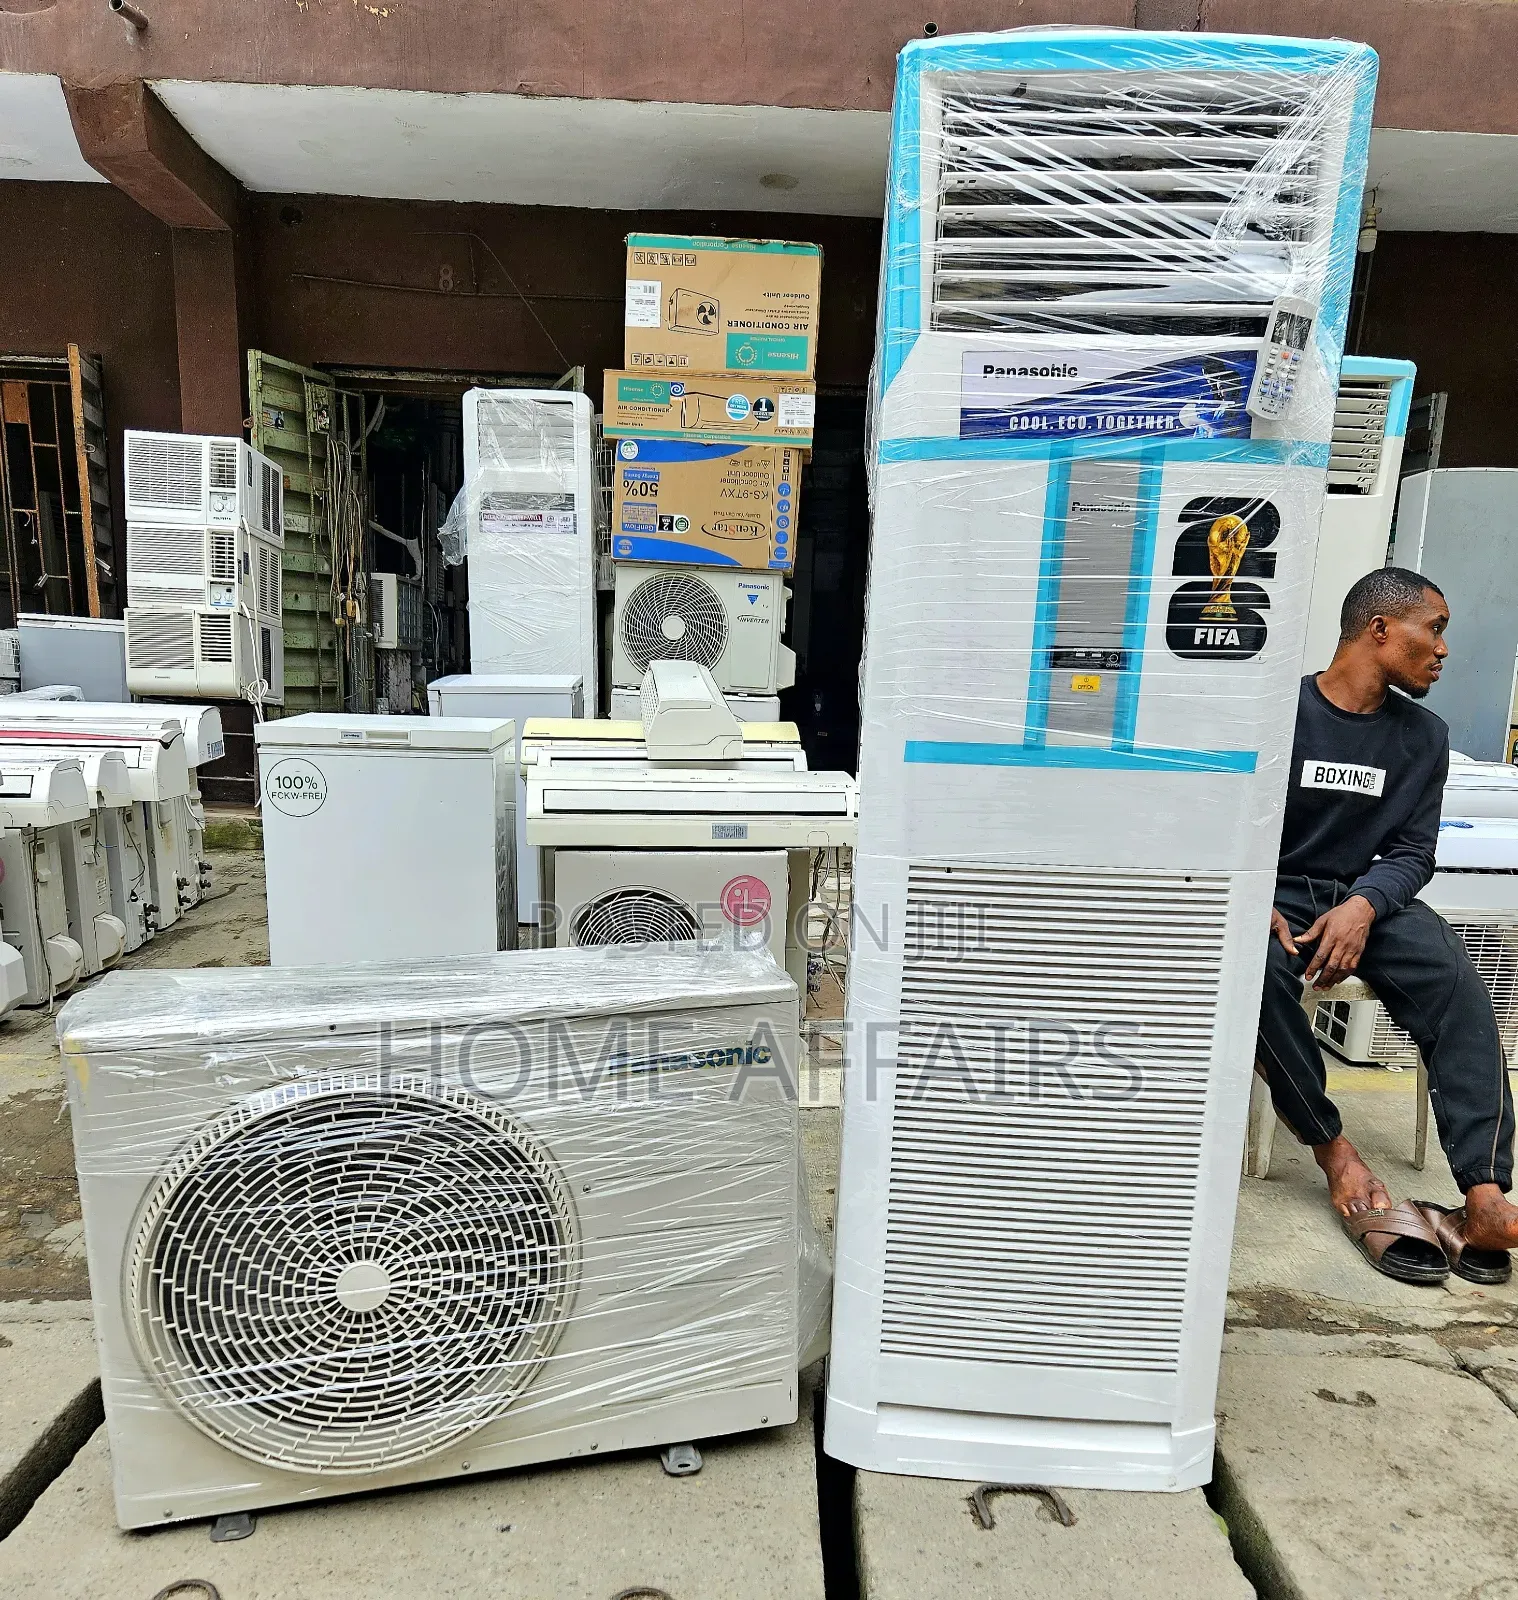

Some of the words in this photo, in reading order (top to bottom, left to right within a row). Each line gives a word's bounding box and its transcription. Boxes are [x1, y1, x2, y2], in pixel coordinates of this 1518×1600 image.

[692, 240, 729, 249] Corporation
[727, 320, 790, 330] CONDITIONER
[767, 351, 799, 359] Hisense
[983, 364, 1078, 378] Panasonic
[1009, 415, 1054, 430] COOL.
[1058, 415, 1092, 430] ECO.
[1097, 414, 1179, 430] TOGETHER.
[726, 470, 741, 478] Unit
[742, 471, 770, 479] Outdoor
[623, 480, 659, 497] 50%
[760, 480, 770, 488] Air
[1071, 501, 1130, 512] Panasonic
[624, 523, 654, 532] GenFlow
[711, 522, 759, 537] KenStar
[738, 582, 770, 590] Panasonic
[1193, 628, 1241, 646] FIFA
[1314, 766, 1372, 788] BOXING
[275, 776, 318, 790] 100%
[272, 792, 323, 800] FCKW-FREI
[723, 878, 769, 923] LG
